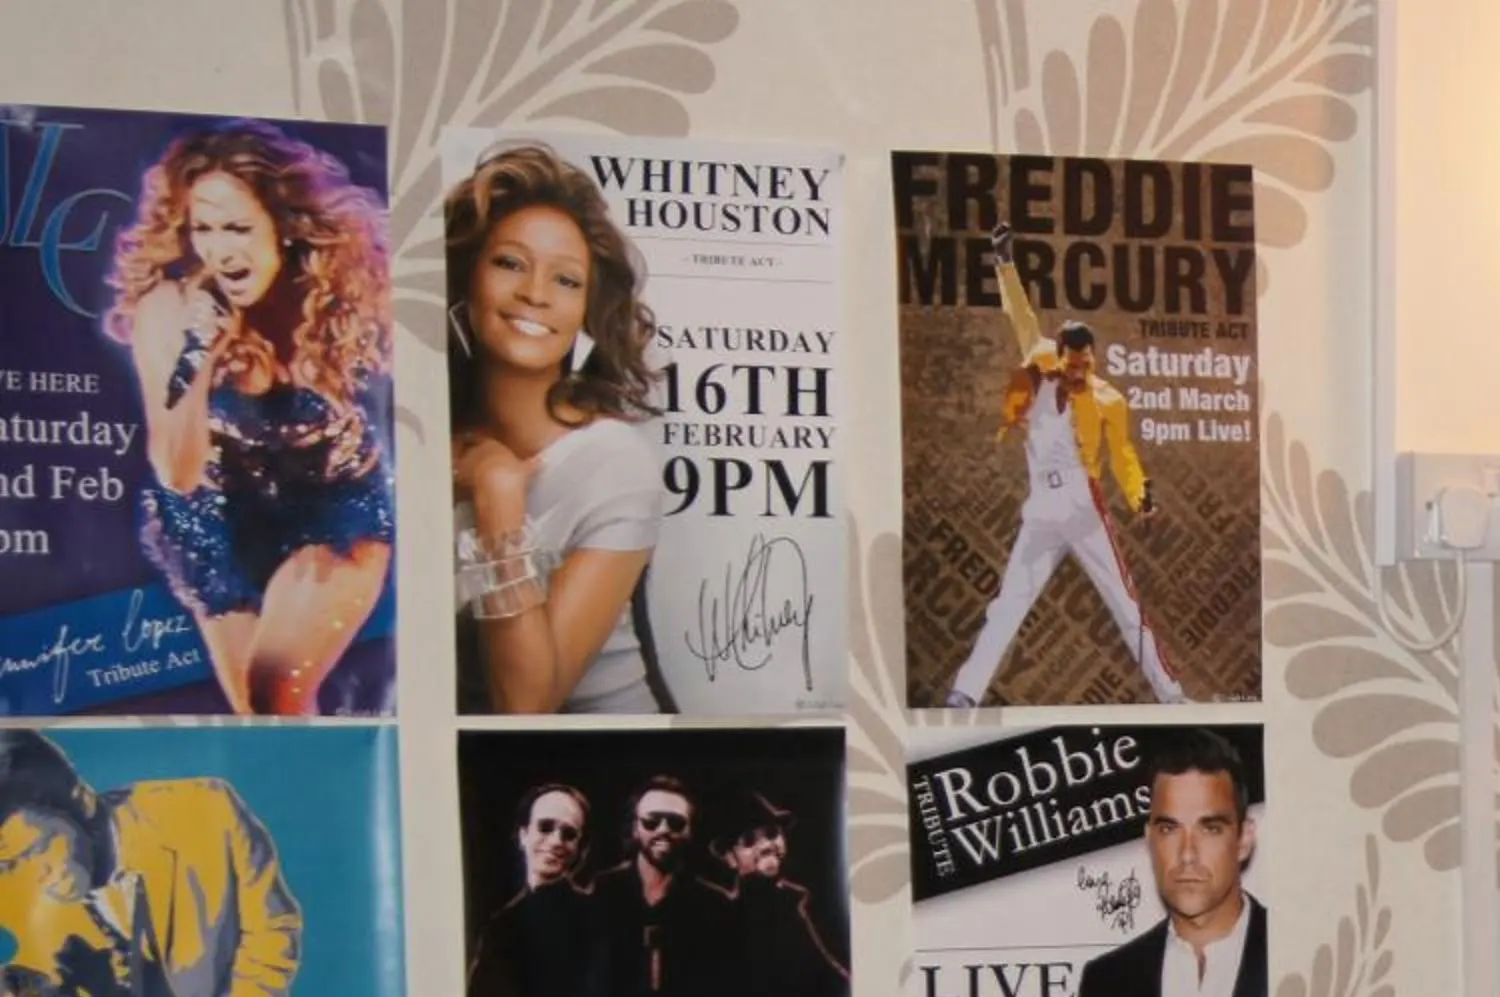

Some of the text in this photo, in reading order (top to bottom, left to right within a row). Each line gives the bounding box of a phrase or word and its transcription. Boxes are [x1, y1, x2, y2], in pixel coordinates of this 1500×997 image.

[589, 155, 831, 202] WHITNEY
[892, 151, 1254, 243] FREDDIE
[625, 197, 831, 236] HOUSTON
[692, 253, 775, 268] TRIBUTE ACT
[901, 236, 1257, 315] MERCURY
[657, 326, 836, 353] SATURDAY
[1139, 319, 1249, 341] TRIBUTE ACT
[30, 371, 101, 394] HERE
[1106, 343, 1251, 385] Saturday
[660, 361, 834, 417] 16TH
[1128, 386, 1250, 412] 2nd March
[663, 422, 837, 449] FEBRUARY
[1140, 418, 1251, 445] 9pm Live!
[48, 465, 124, 501] Feb
[662, 455, 835, 518] 9PM
[86, 647, 202, 688] Tribute Act
[913, 727, 1142, 877] TRIBUTE Robbie
[951, 783, 1151, 866] Williams
